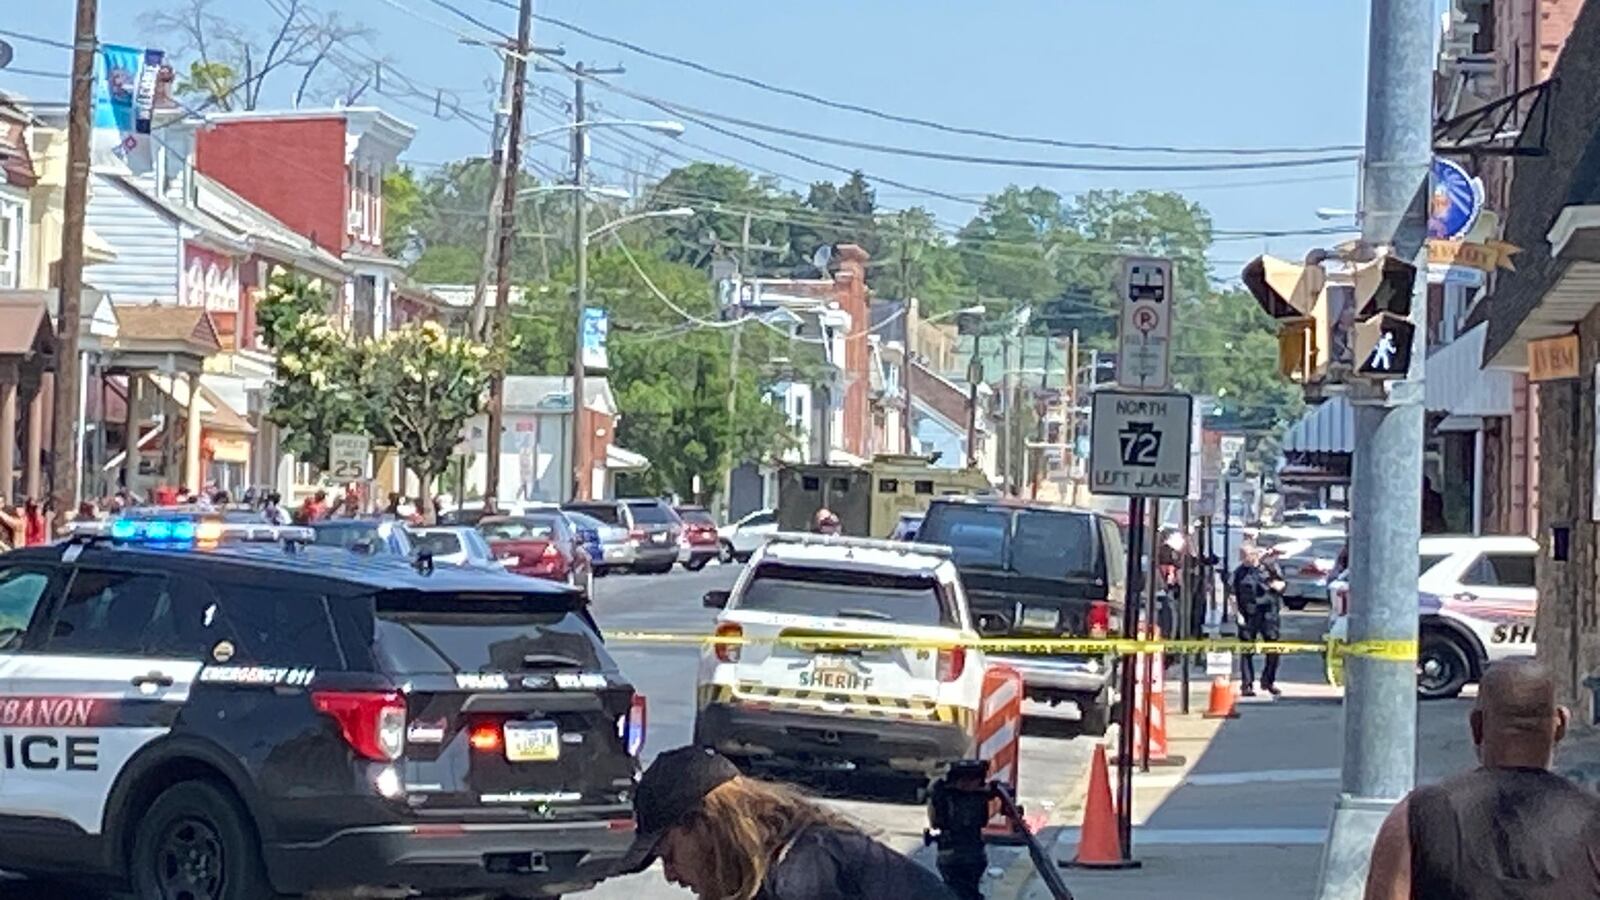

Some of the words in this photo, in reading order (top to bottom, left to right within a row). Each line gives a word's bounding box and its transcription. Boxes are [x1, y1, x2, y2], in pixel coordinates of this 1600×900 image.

[1116, 401, 1167, 416] NORTH
[1119, 432, 1157, 461] 72
[335, 460, 363, 478] 25
[1096, 470, 1130, 486] LEFT
[1140, 472, 1180, 489] LANE
[200, 666, 288, 683] EMERGENCY
[799, 670, 875, 691] SHERIFF
[0, 698, 95, 726] BANON
